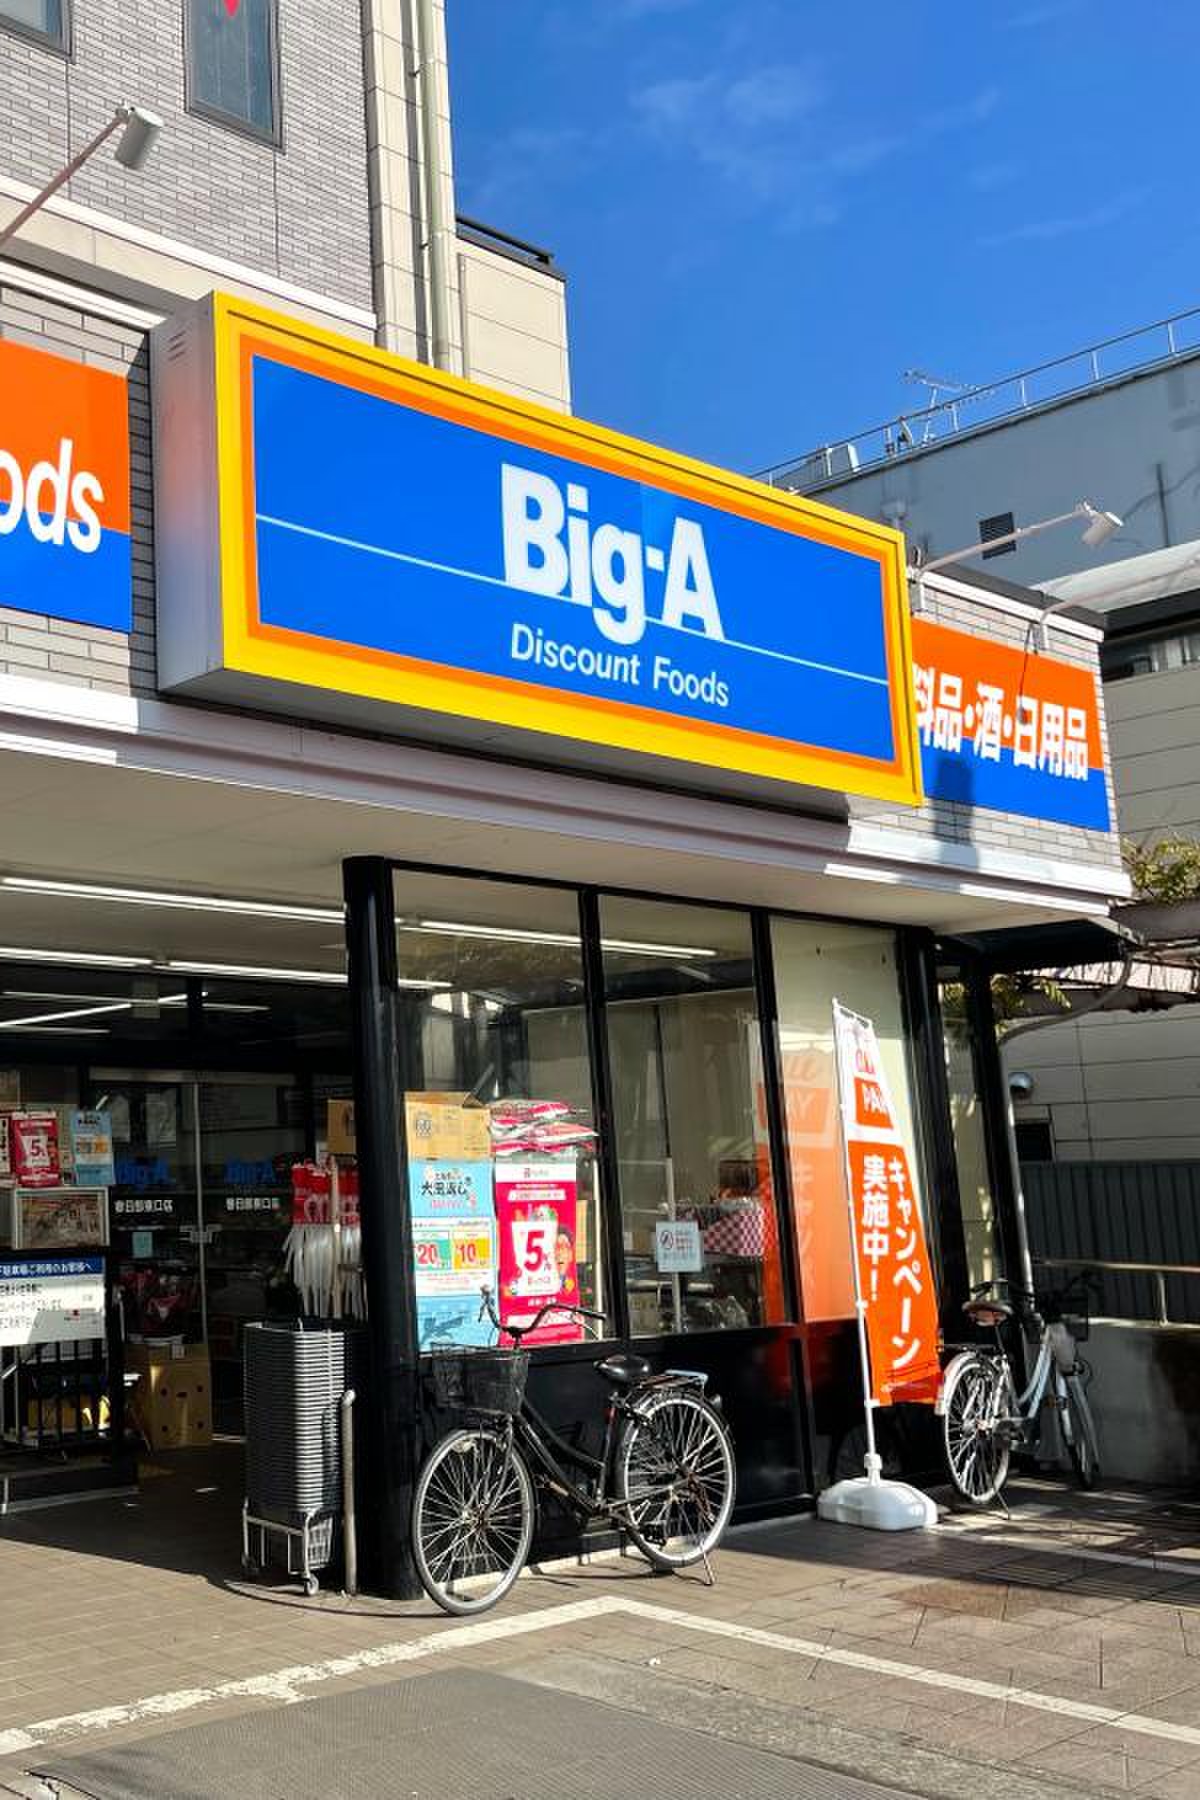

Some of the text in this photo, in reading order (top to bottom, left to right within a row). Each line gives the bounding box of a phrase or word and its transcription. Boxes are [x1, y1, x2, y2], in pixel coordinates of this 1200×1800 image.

[501, 463, 725, 645] Big-A
[511, 623, 729, 707] Discount Foods
[889, 1157, 923, 1369] キャンペーン
